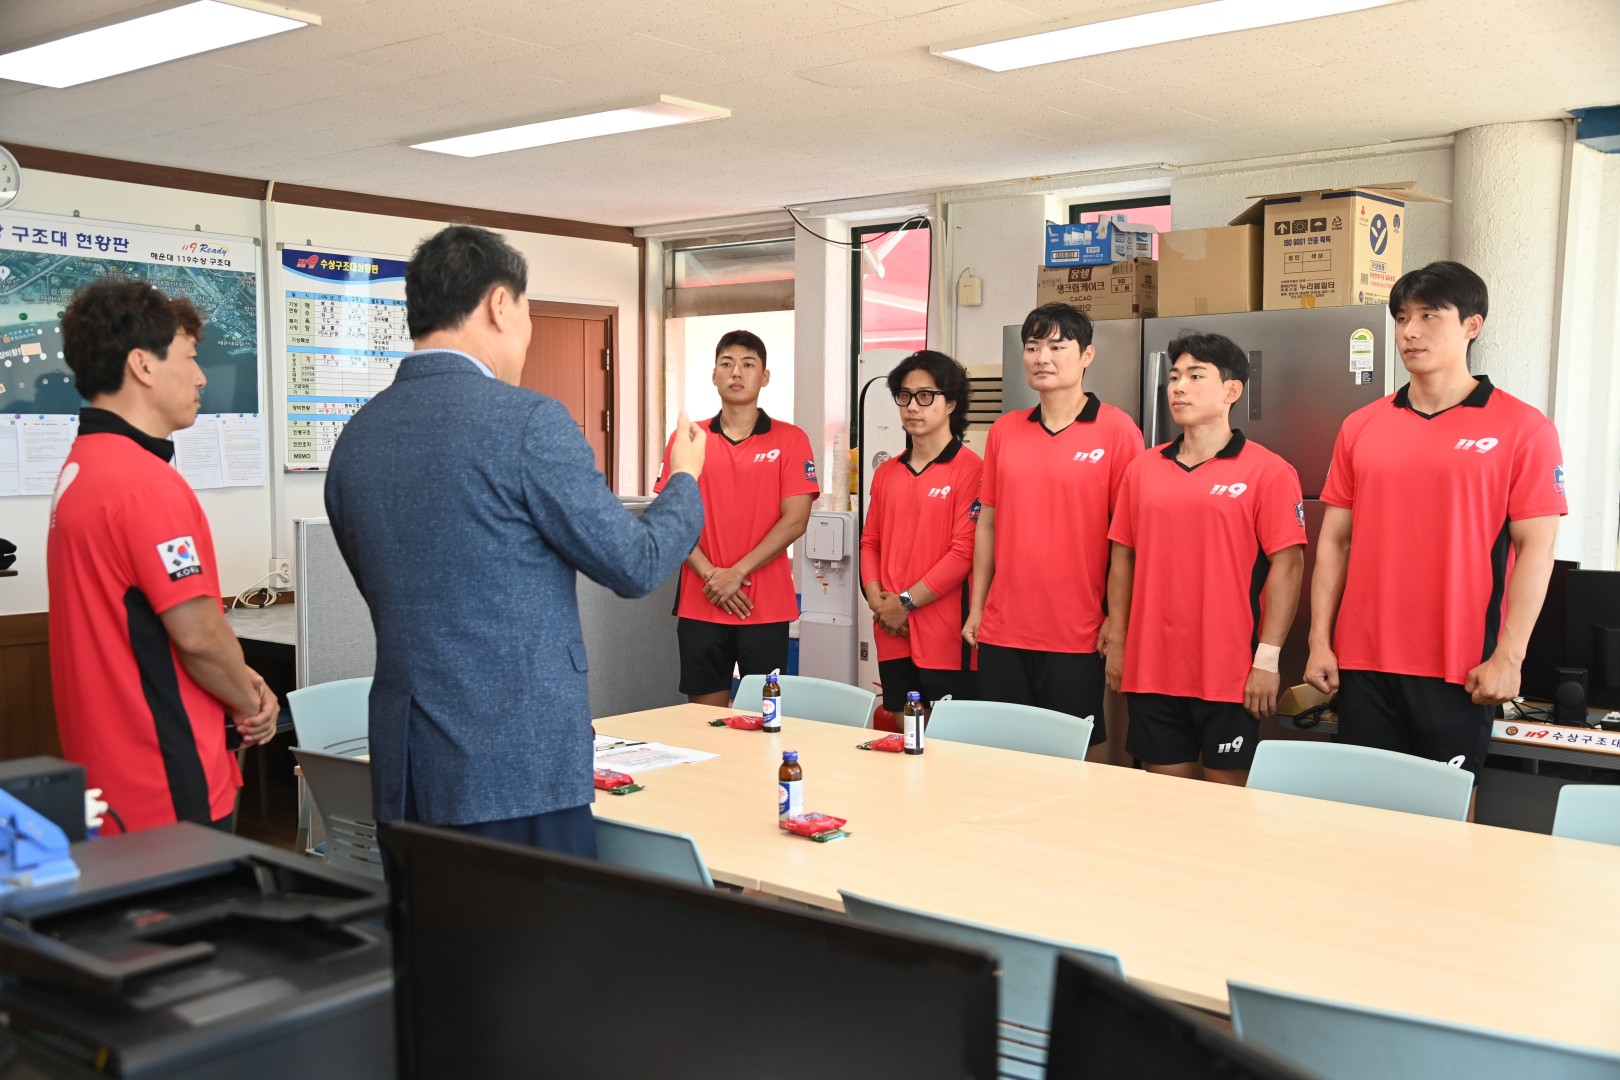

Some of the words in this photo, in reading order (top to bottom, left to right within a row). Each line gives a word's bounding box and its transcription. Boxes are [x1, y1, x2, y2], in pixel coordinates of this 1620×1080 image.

[12, 226, 68, 248] 구조대
[76, 232, 130, 254] 현황판
[182, 242, 198, 254] 119
[199, 243, 229, 256] Ready
[150, 252, 174, 262] 해운대
[176, 254, 208, 266] 119수상
[209, 257, 232, 268] 구조대
[296, 255, 319, 269] 119
[320, 259, 378, 274] 수상구조대상황판
[1056, 282, 1105, 294] 생크림케이크
[1453, 437, 1499, 454] 119
[752, 449, 780, 463] 119
[1072, 448, 1105, 464] 119
[928, 485, 951, 499] 119
[1209, 482, 1248, 498] 119
[1524, 730, 1550, 739] 119
[1218, 735, 1244, 753] 119
